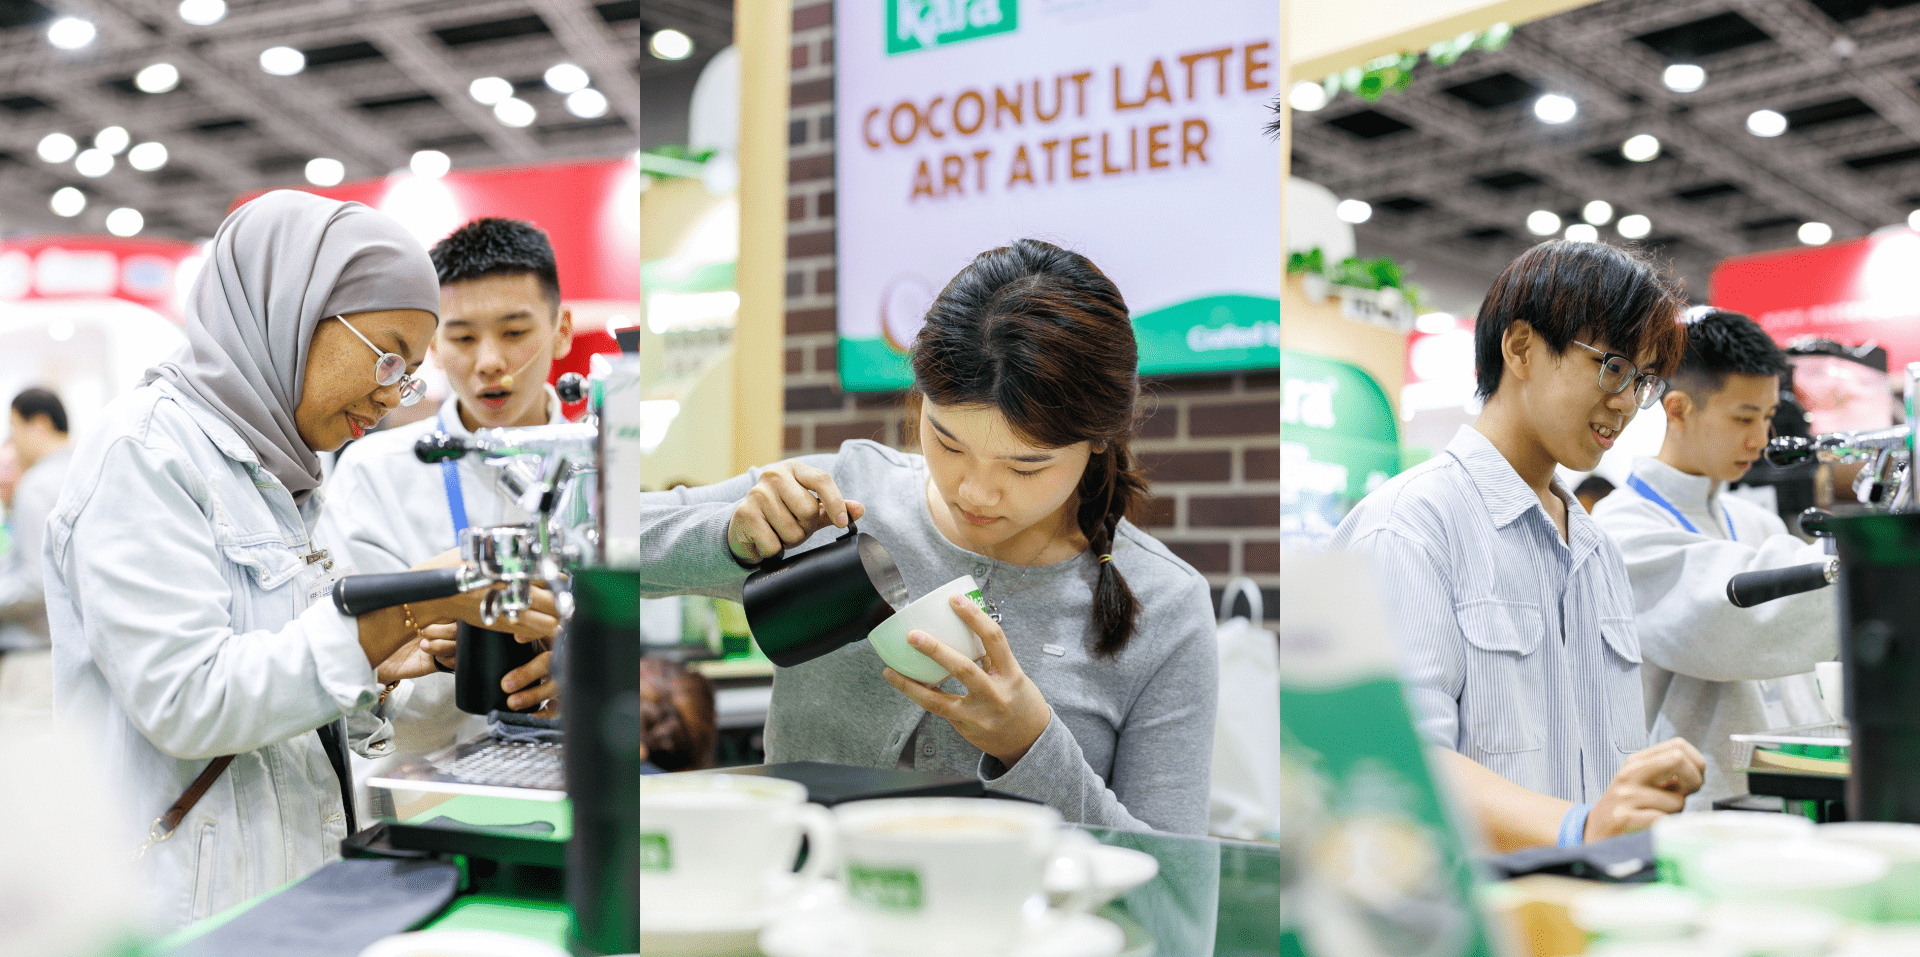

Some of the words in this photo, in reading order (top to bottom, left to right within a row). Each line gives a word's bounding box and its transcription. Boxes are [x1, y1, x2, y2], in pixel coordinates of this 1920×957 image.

[862, 70, 1093, 151] COCONUT
[1113, 40, 1271, 112] LATTE
[910, 149, 992, 200] ART
[1007, 118, 1210, 187] ATELIER
